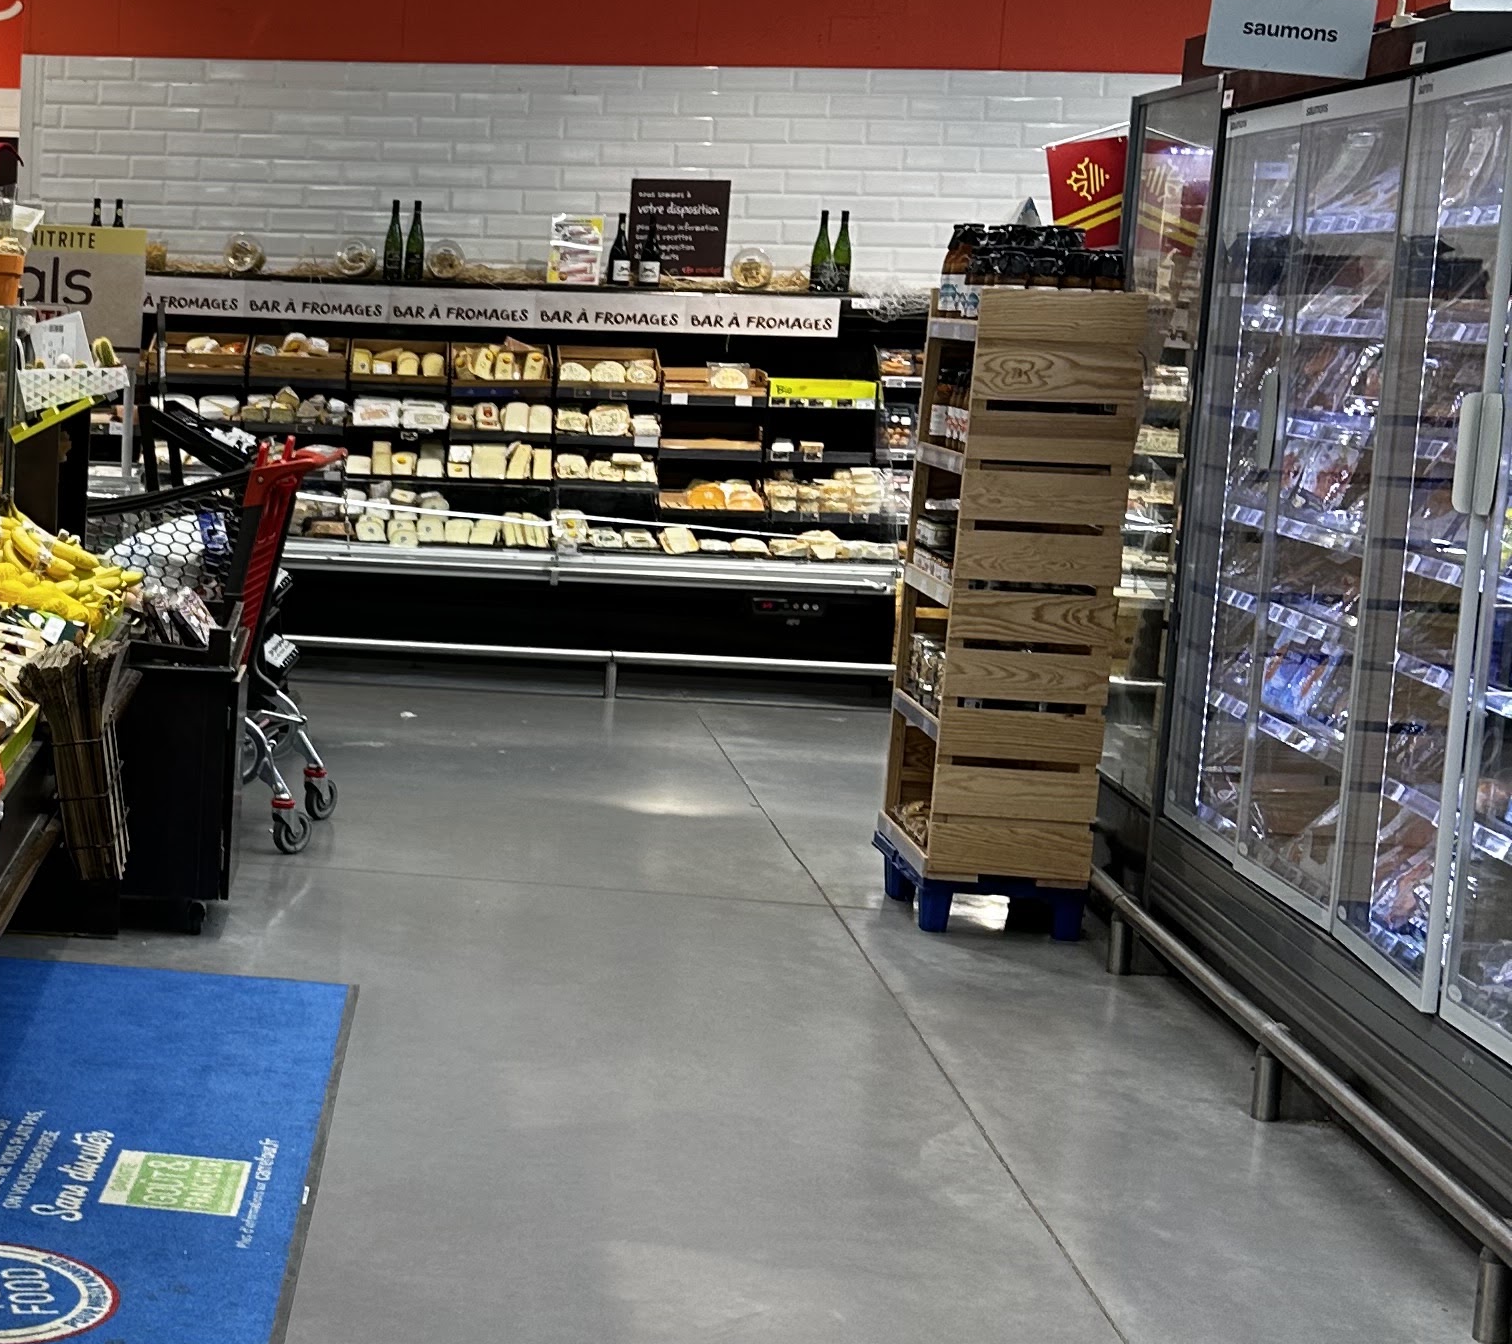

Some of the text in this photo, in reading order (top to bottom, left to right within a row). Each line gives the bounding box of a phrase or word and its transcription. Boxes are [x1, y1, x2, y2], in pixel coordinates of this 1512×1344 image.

[1243, 21, 1338, 43] saumons
[666, 201, 720, 219] disposition
[143, 292, 239, 312] À FROMAGES
[249, 297, 383, 318] BAR À FROMAGES
[393, 304, 529, 323] BAR À FROMAGES
[540, 306, 679, 327] BAR À FROMAGES
[690, 311, 833, 331] BAR À FROMAGES
[31, 1130, 115, 1222] Sans discuter
[140, 1160, 192, 1205] GOÛT &
[0, 1267, 60, 1315] FOOD
